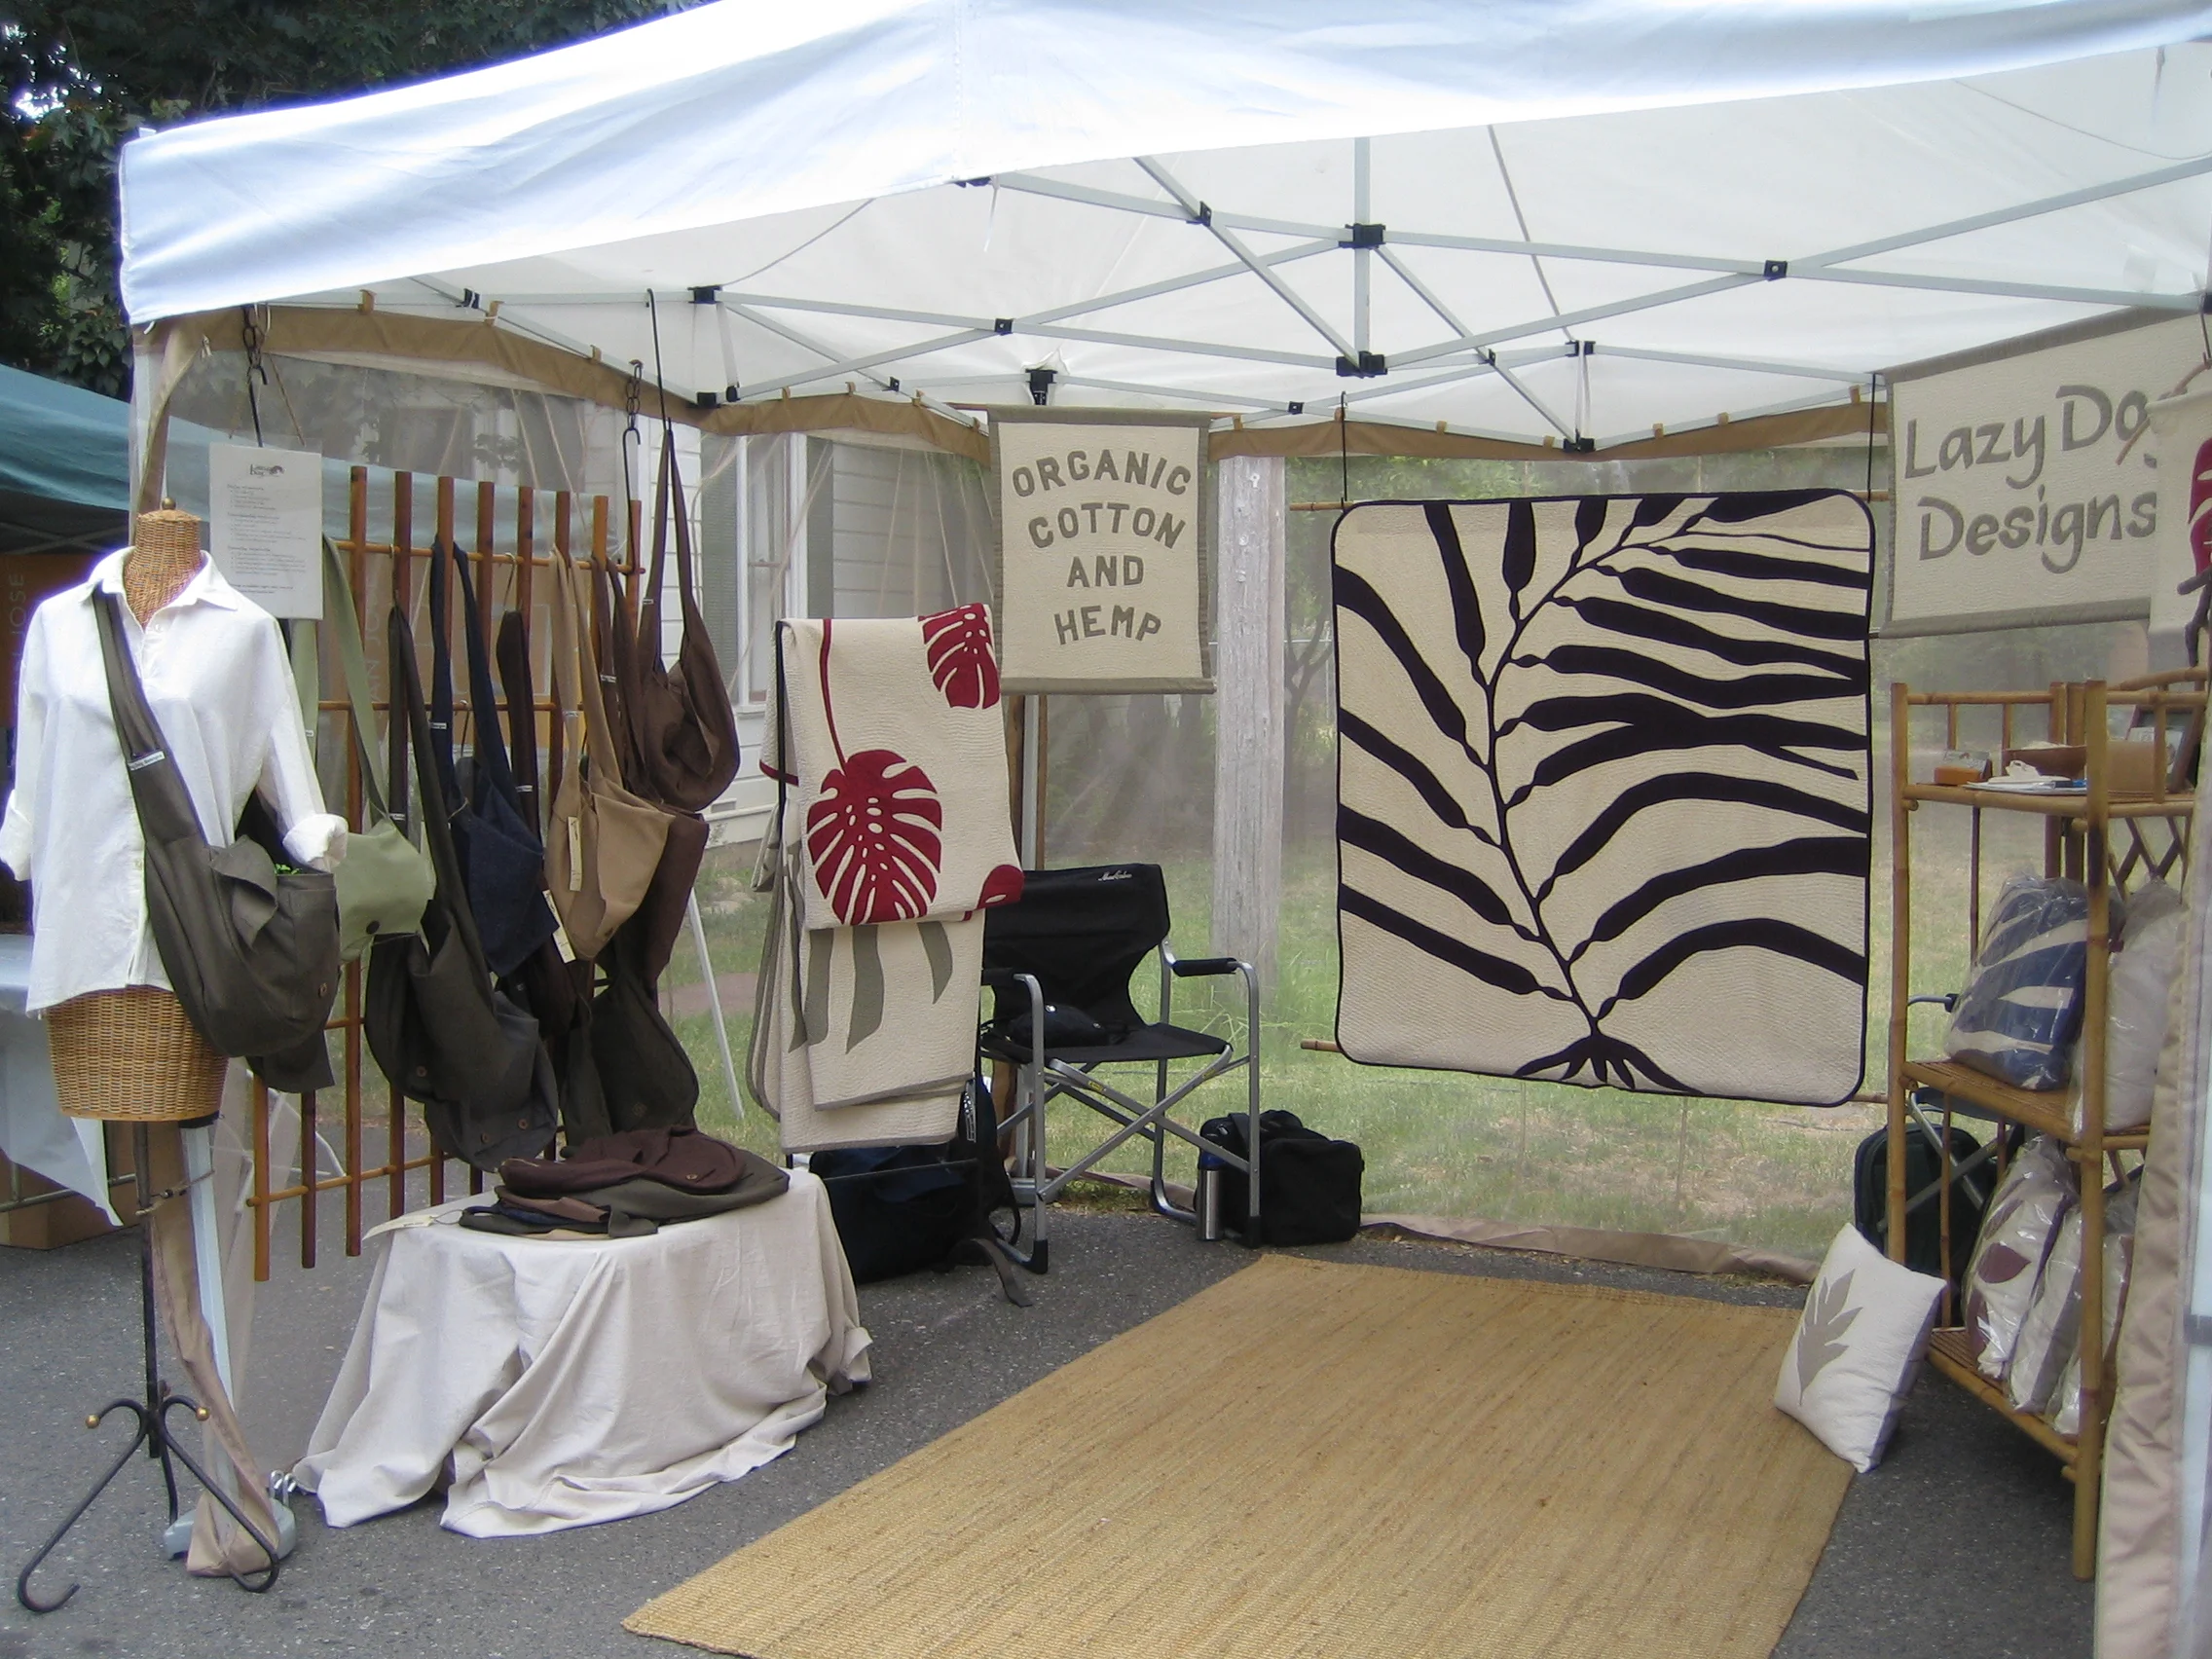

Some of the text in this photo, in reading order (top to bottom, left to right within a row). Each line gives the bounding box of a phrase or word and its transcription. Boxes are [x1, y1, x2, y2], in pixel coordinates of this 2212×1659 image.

[1904, 385, 2188, 490] Lazy Do
[1013, 449, 1191, 497] ORGANIC
[1028, 501, 1186, 549] COTTON
[1917, 485, 2157, 574] Designs
[1067, 554, 1145, 589] AND
[1054, 605, 1162, 645] HEMP
